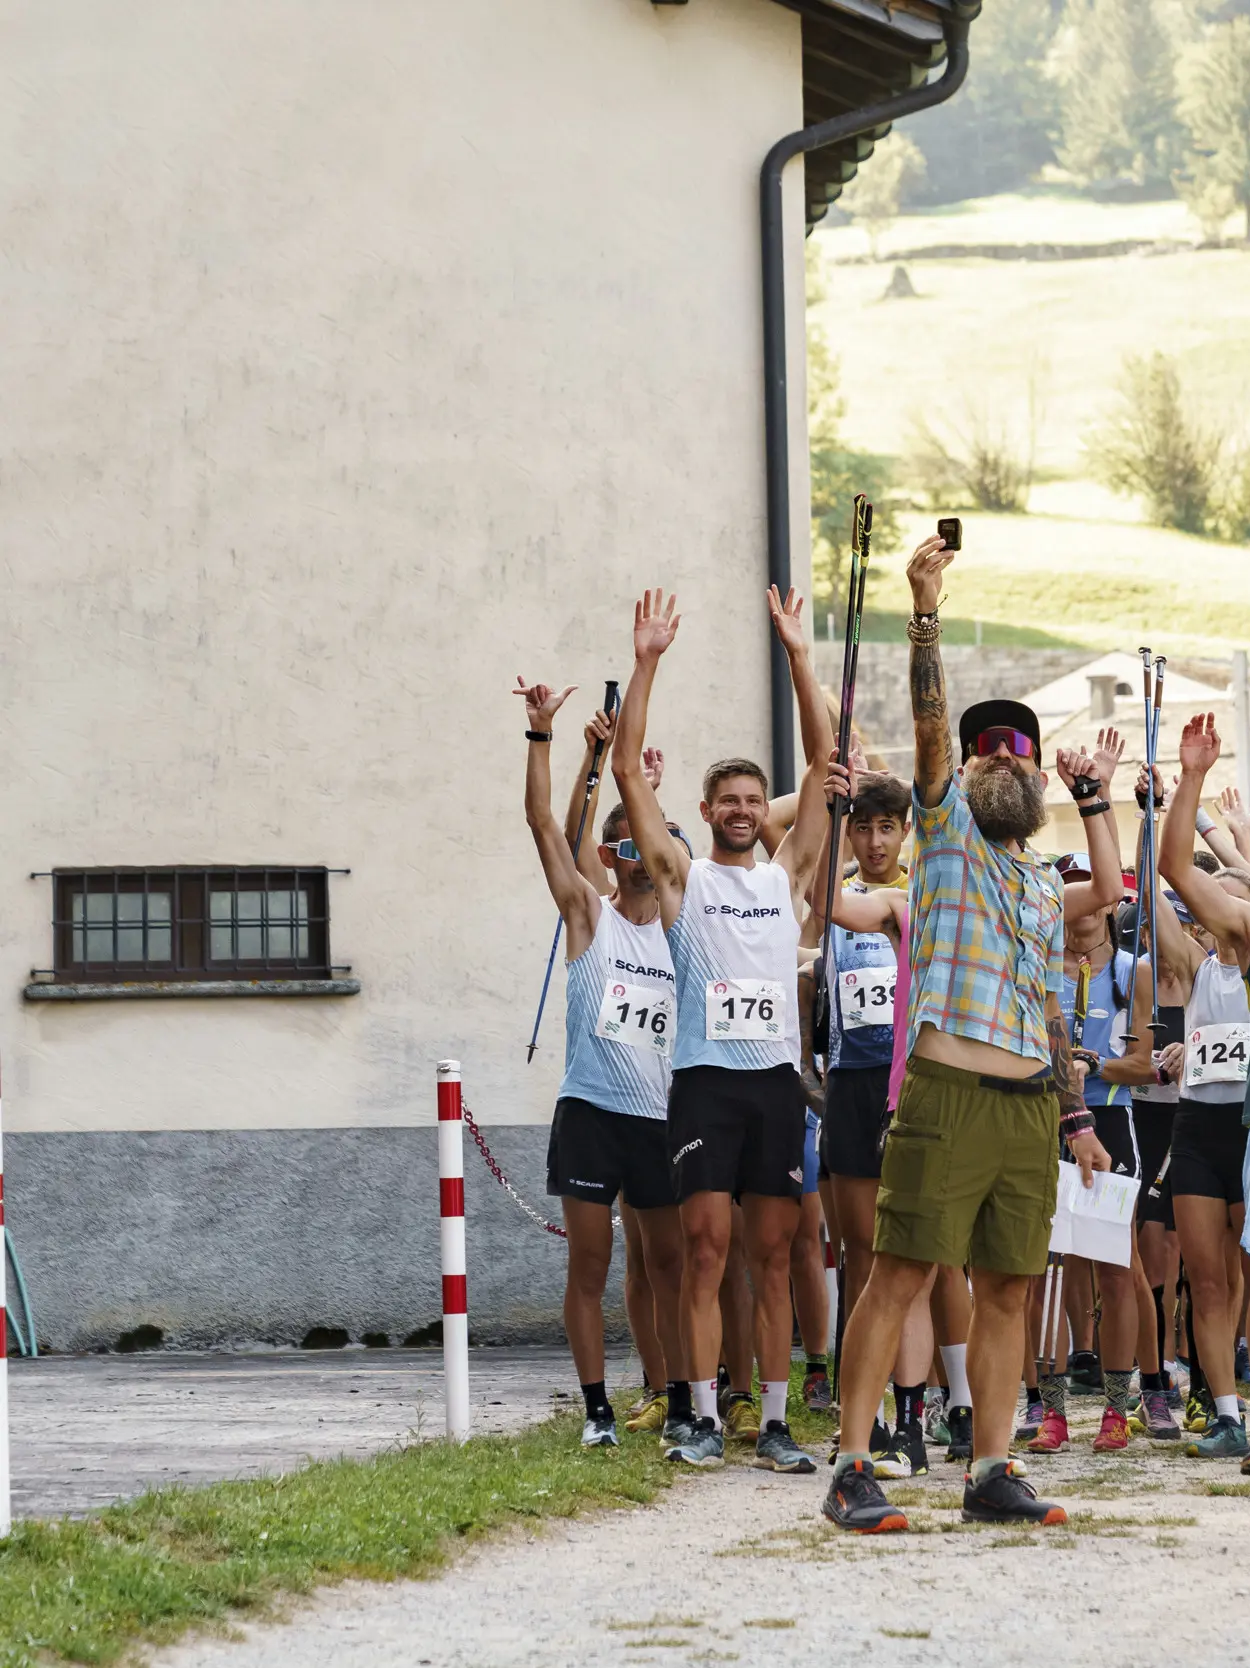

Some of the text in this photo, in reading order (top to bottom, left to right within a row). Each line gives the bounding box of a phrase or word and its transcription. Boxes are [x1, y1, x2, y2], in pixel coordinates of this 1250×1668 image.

[720, 905, 779, 919] SCARPA
[855, 942, 880, 951] AVIS
[615, 959, 675, 984] SCARPA
[616, 1002, 667, 1034] 116
[722, 997, 774, 1020] 176
[1197, 1042, 1246, 1065] 124
[575, 1180, 604, 1189] SCARPA
